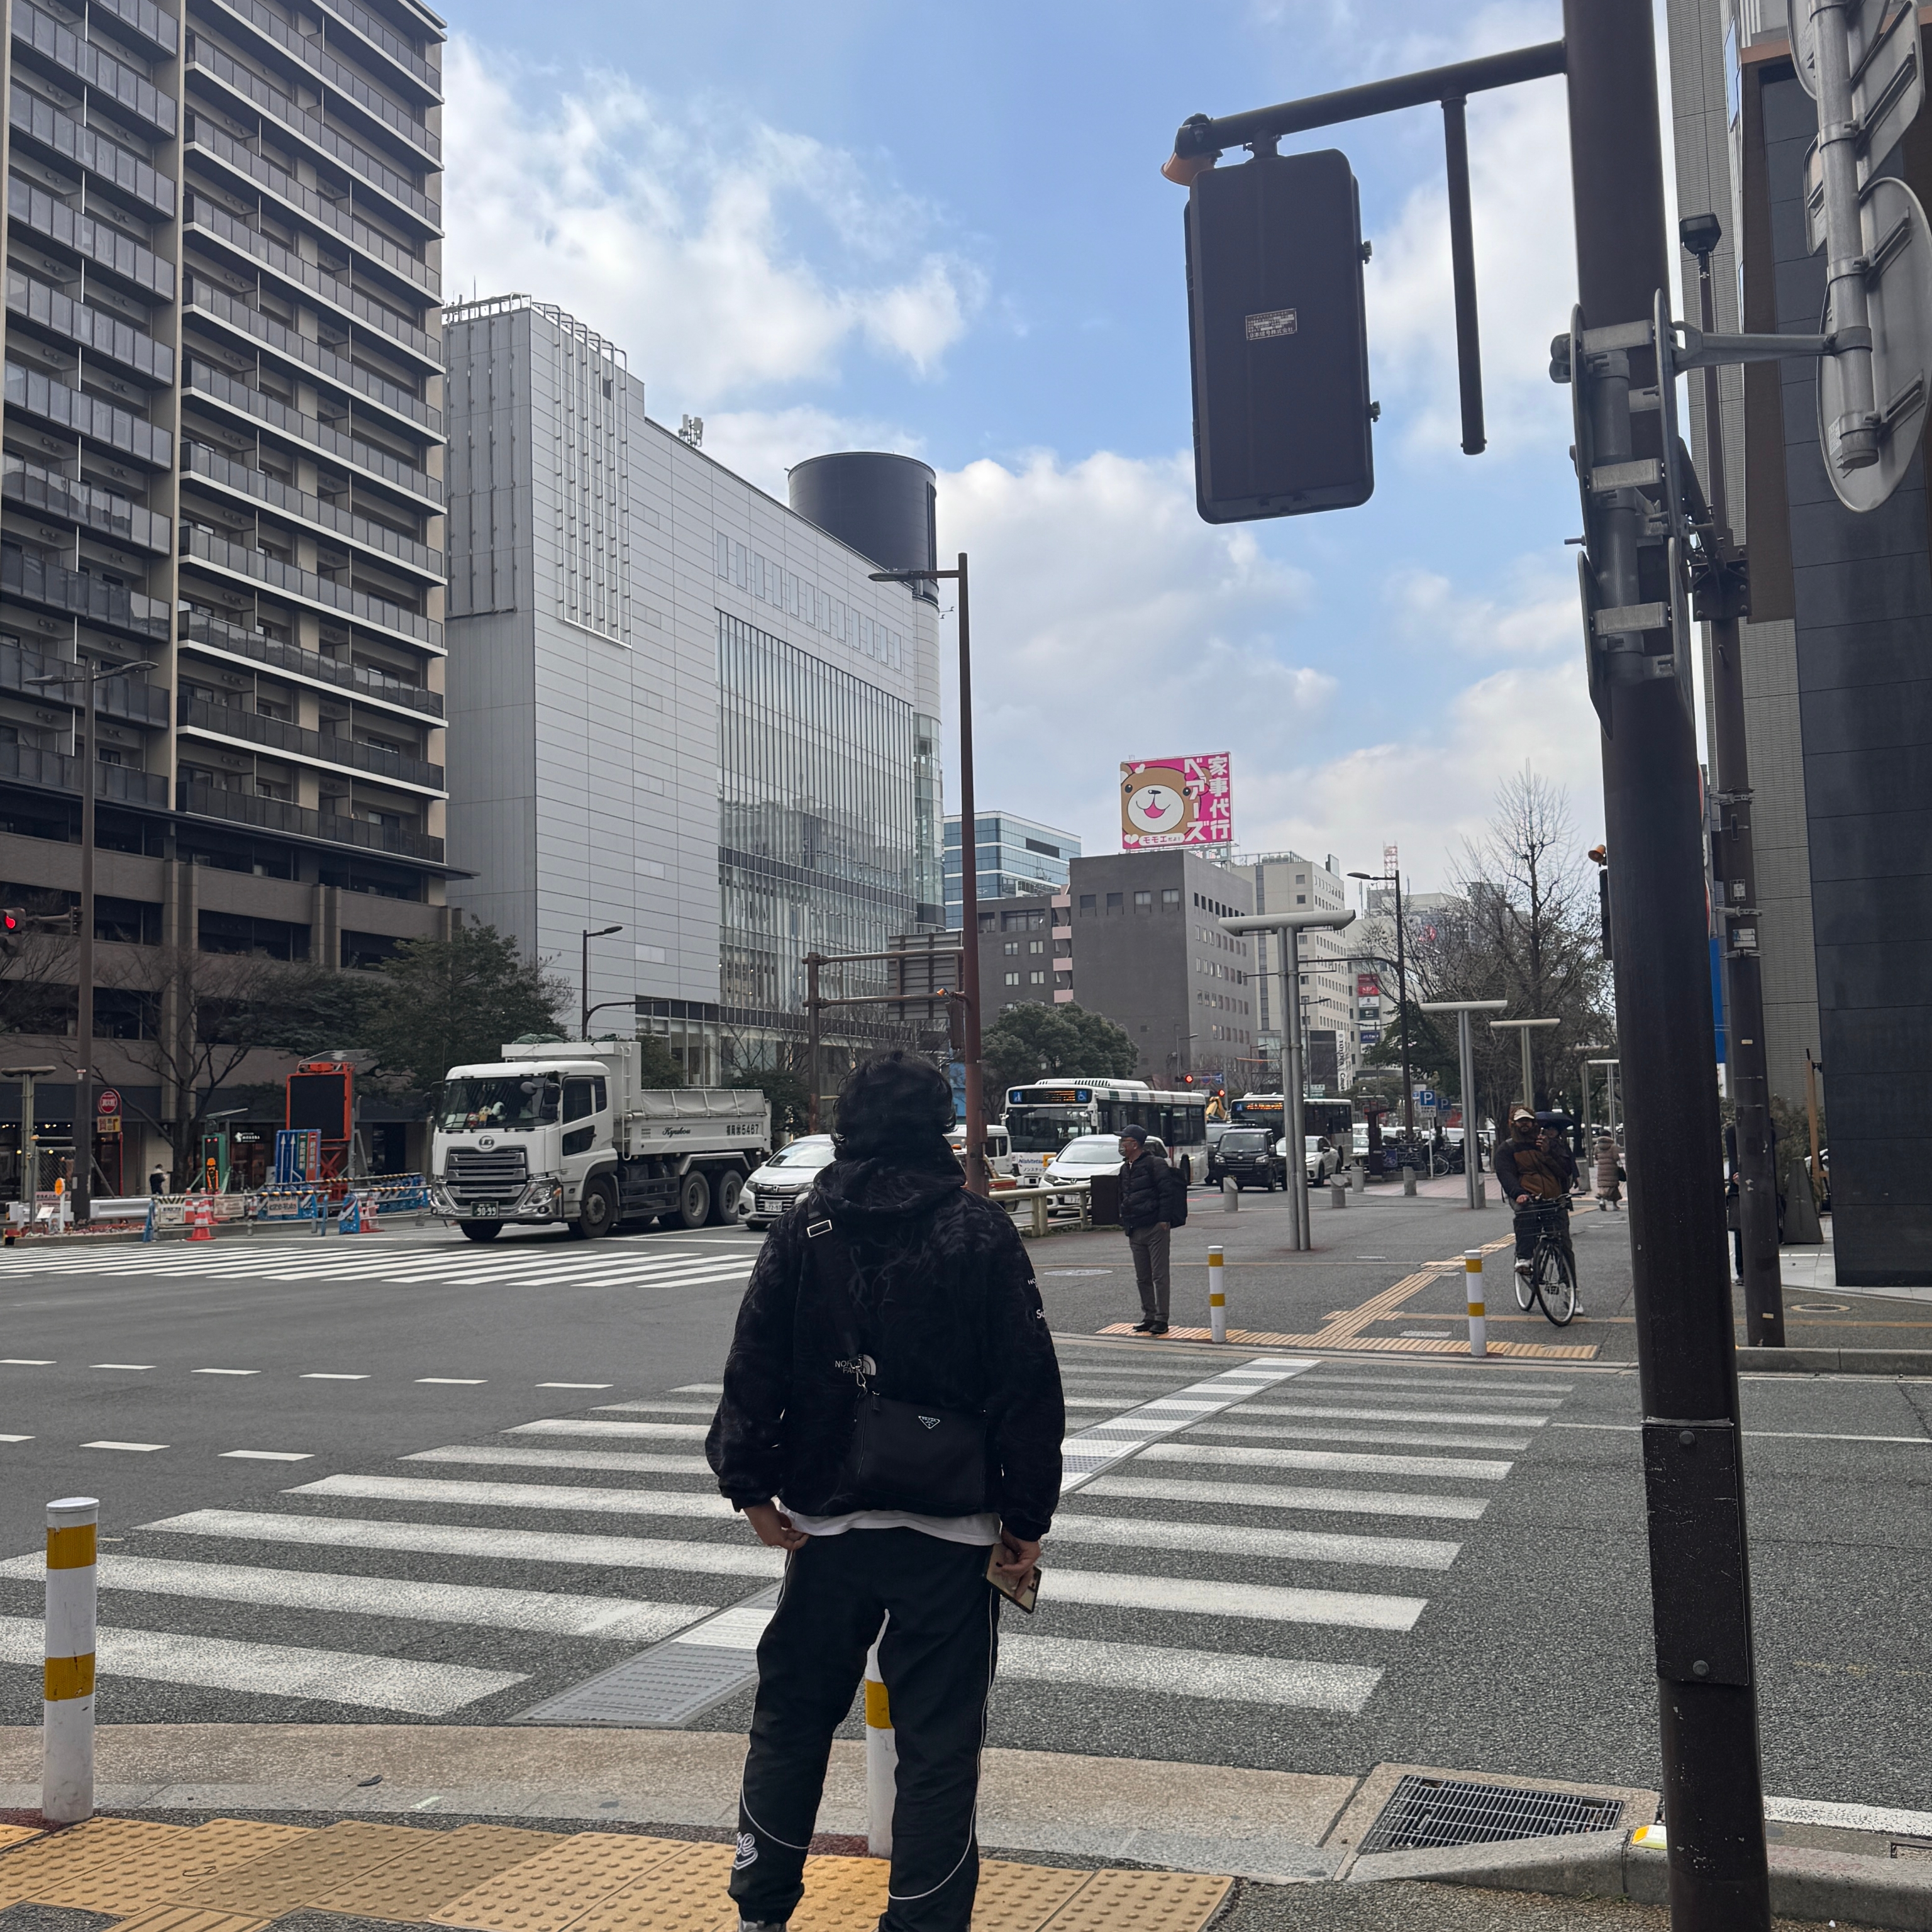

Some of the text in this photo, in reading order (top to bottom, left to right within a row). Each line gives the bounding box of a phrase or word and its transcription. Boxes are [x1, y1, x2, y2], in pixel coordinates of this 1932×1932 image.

[1184, 757, 1209, 841] ベアーズ
[1208, 756, 1230, 840] 家事代行
[1424, 1092, 1433, 1104] P
